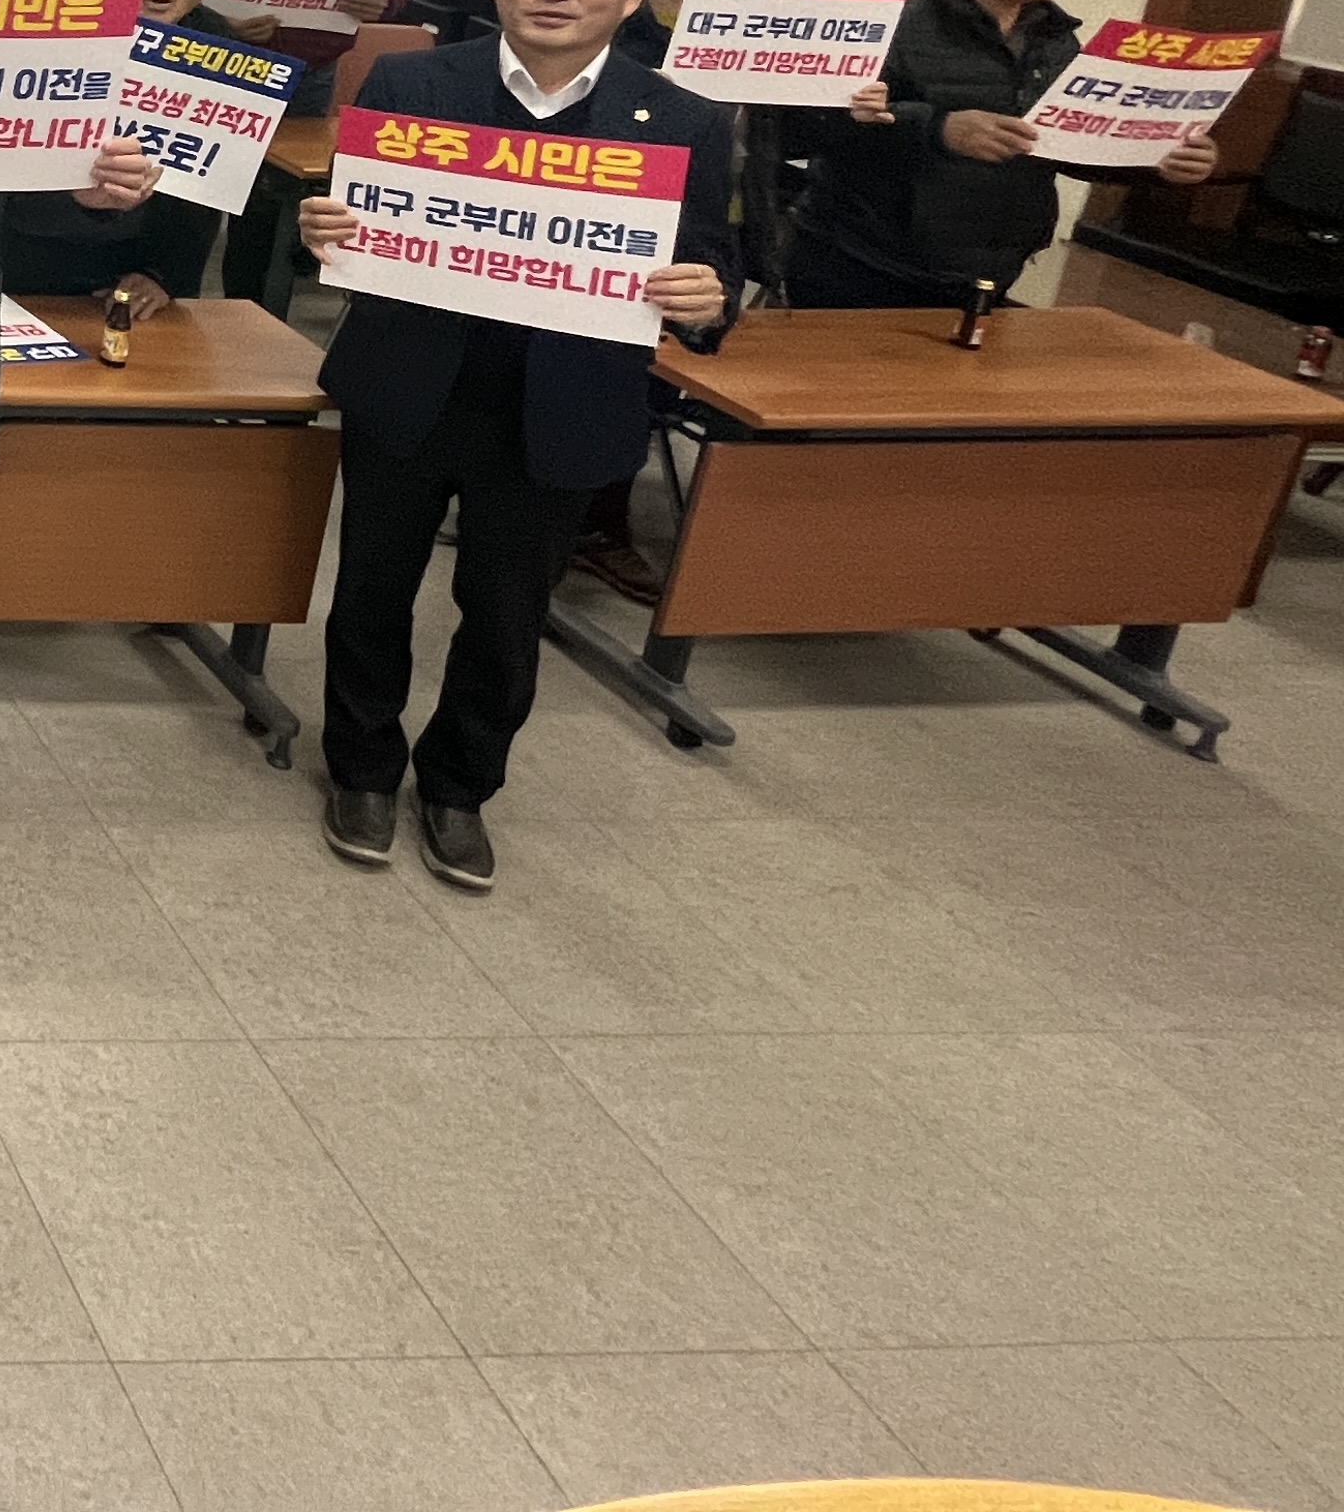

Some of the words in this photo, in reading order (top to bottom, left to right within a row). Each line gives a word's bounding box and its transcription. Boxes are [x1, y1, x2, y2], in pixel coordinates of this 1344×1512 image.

[686, 11, 738, 36] 대구
[742, 14, 817, 40] 군부대
[820, 19, 887, 43] 이전을
[134, 26, 164, 54] 구
[162, 35, 228, 71] 군부대
[225, 50, 292, 90] 이전은
[673, 46, 747, 72] 간절히
[750, 50, 879, 77] 희망합니다!
[1115, 29, 1194, 63] 상주
[13, 68, 111, 101] 이전을
[1063, 76, 1123, 102] 대구
[119, 78, 192, 118] 군상생
[189, 99, 272, 142] 최적지
[375, 119, 470, 166] 상주
[483, 136, 645, 190] 시민은
[346, 181, 415, 218] 대구
[425, 195, 535, 241] 군부대
[547, 215, 659, 258] 이전을
[26, 345, 79, 361] 대구
